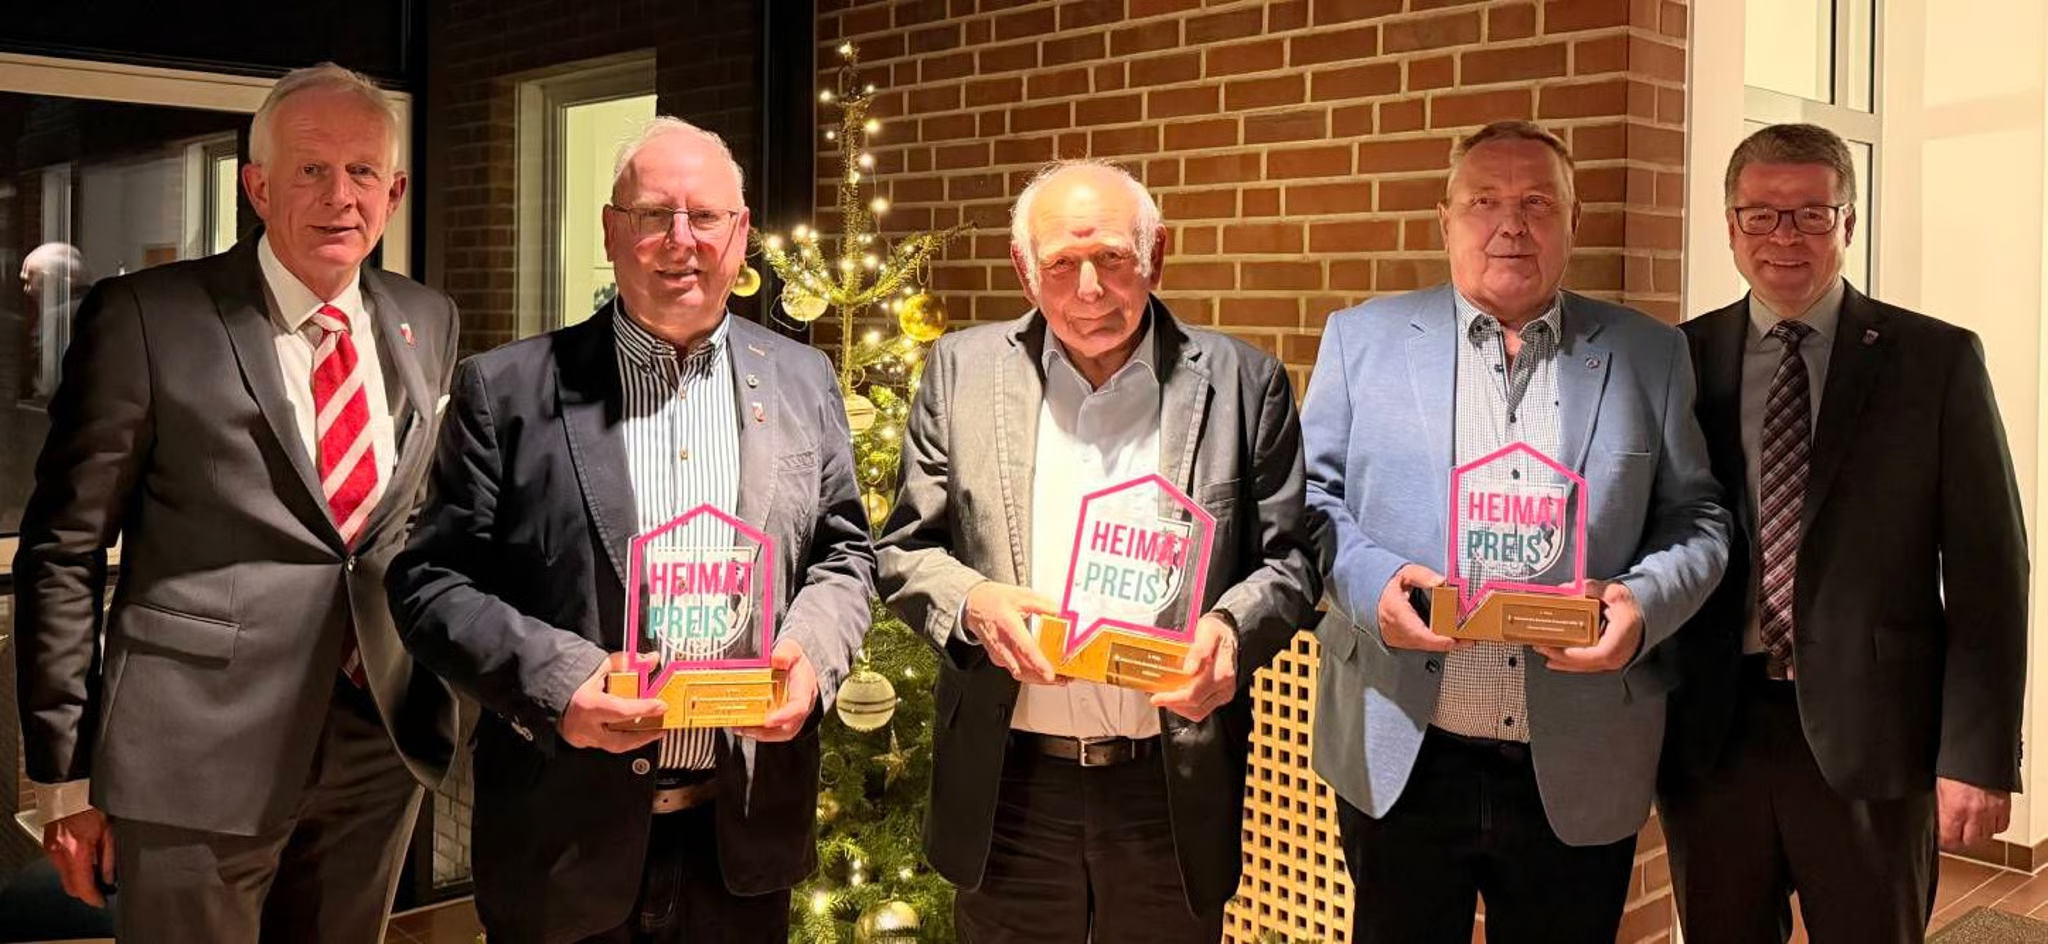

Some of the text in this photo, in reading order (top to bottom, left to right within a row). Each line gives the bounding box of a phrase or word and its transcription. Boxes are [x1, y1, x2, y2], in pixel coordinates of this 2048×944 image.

[1468, 492, 1566, 526] HEIMAT
[1090, 520, 1194, 567] HEIMAT
[1467, 530, 1542, 564] PREIS
[649, 562, 753, 595] HEIMAT
[1083, 562, 1160, 605] PREIS
[646, 605, 729, 639] PREIS
